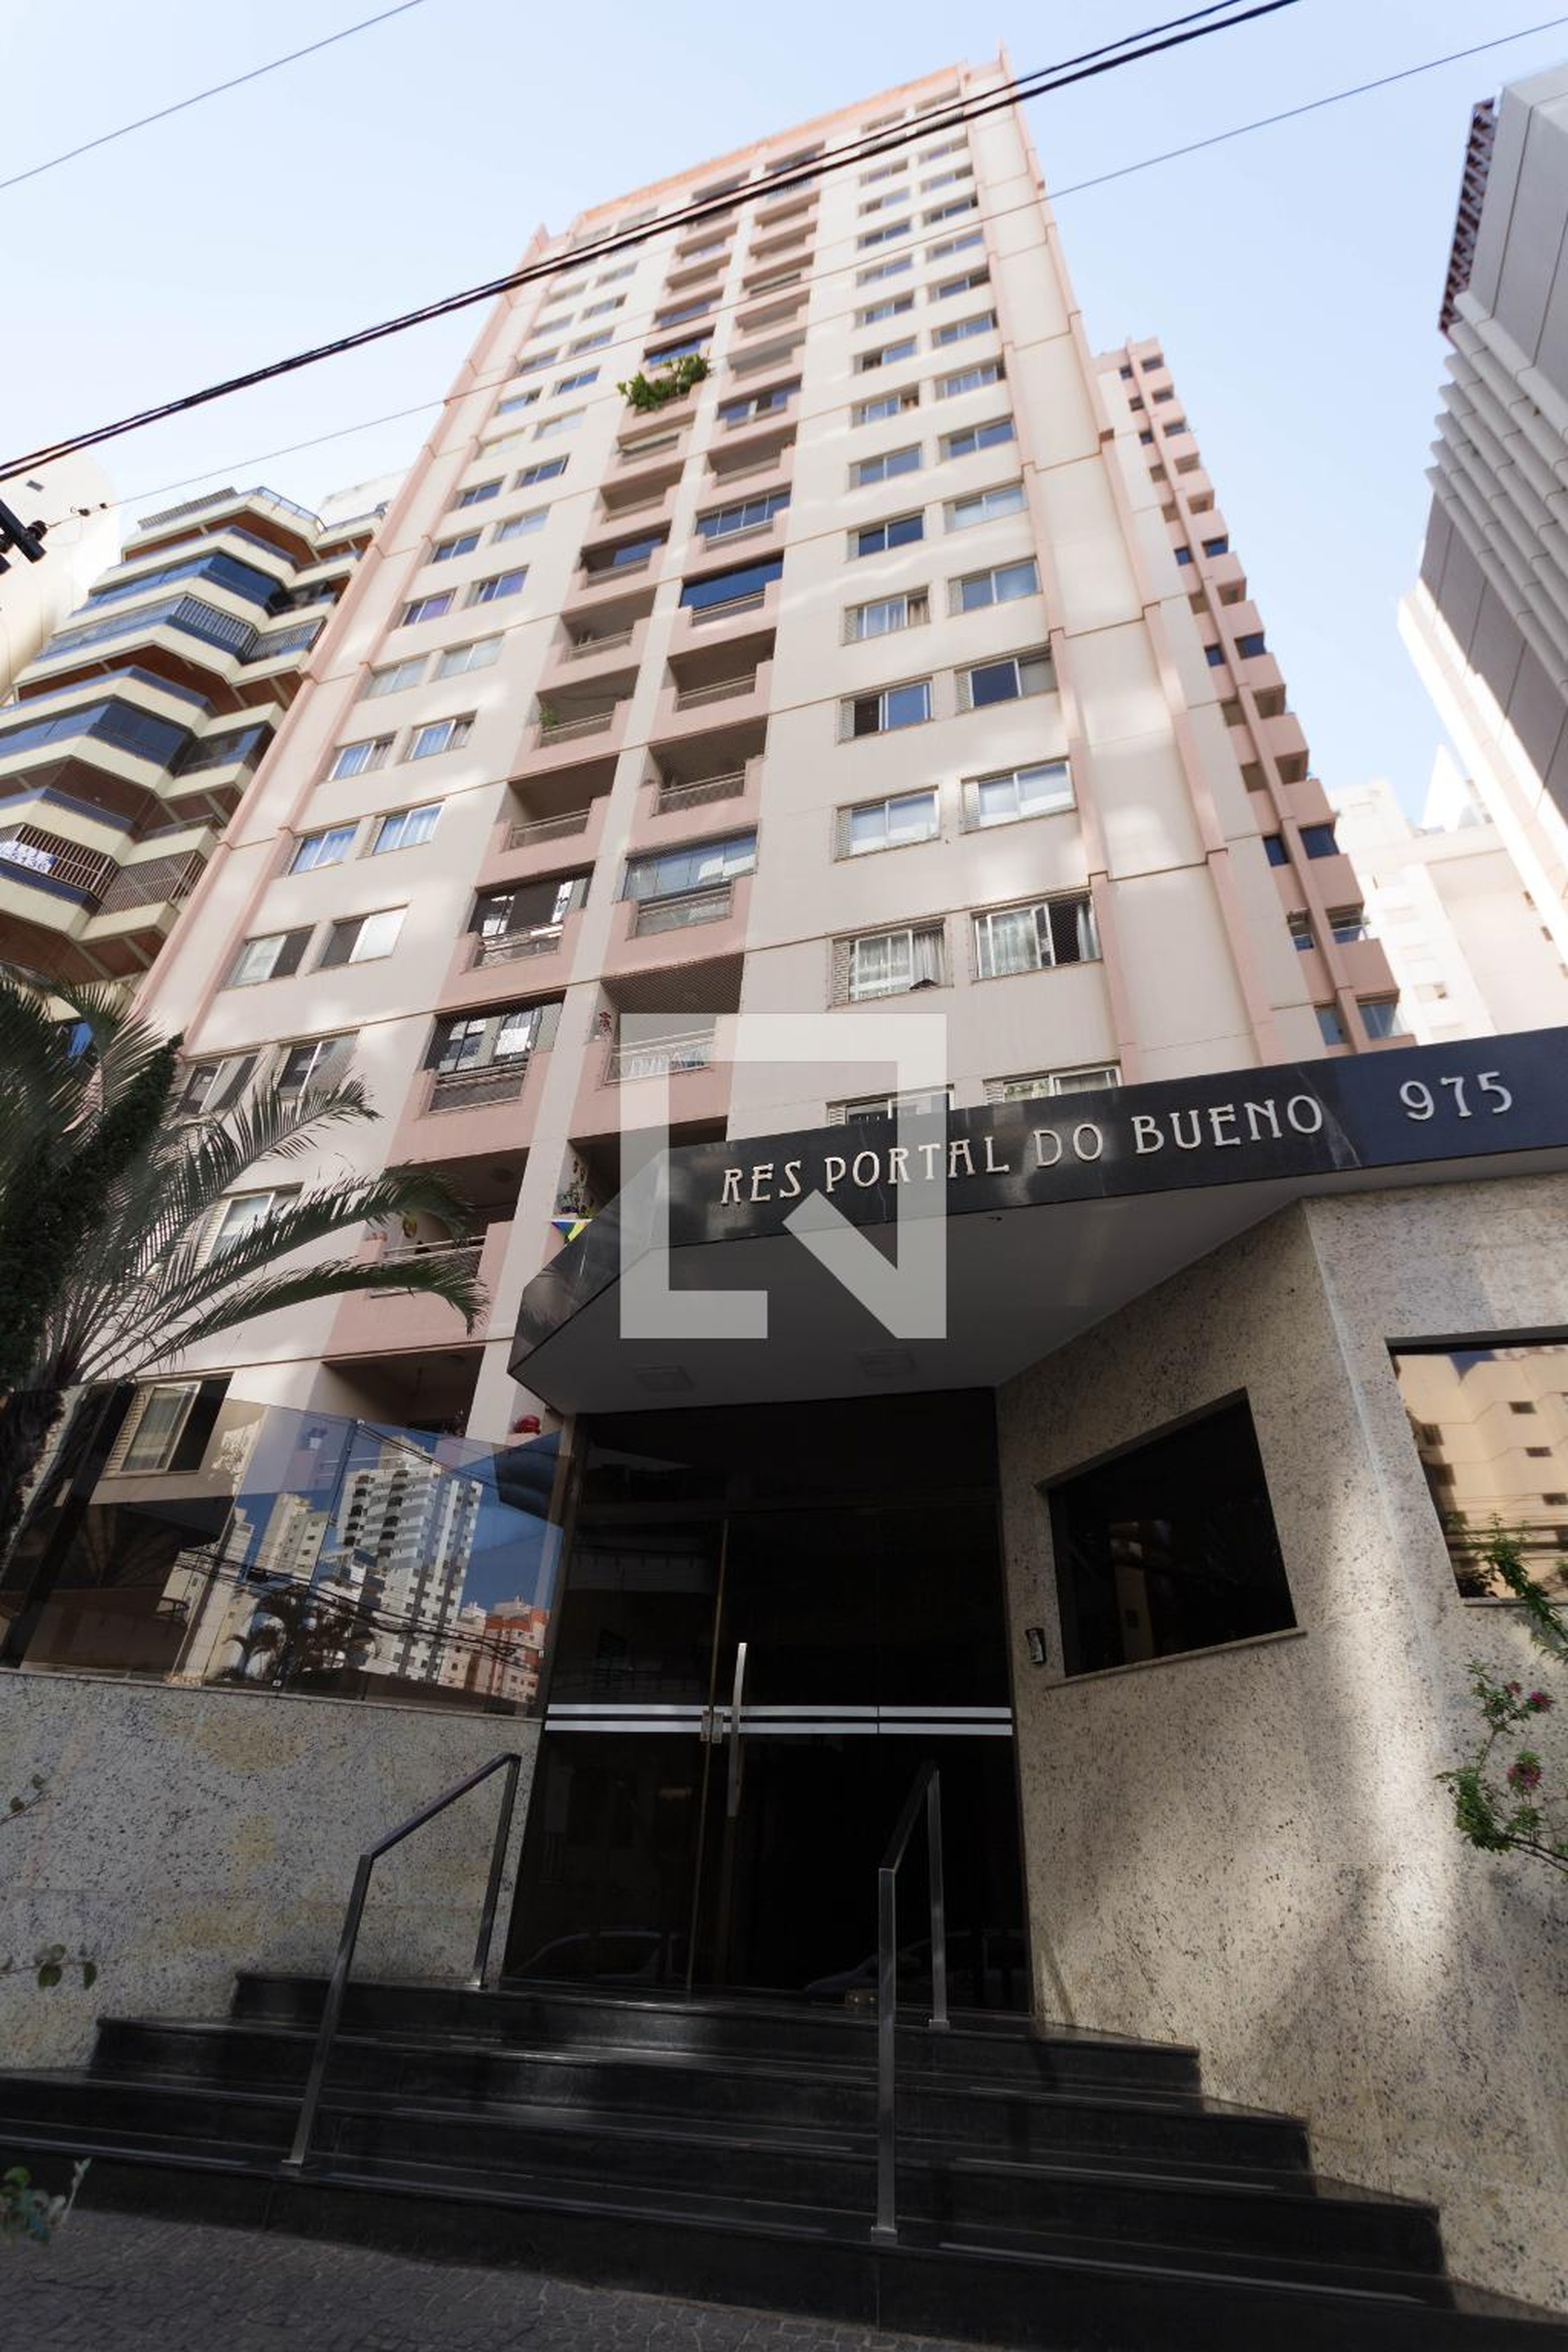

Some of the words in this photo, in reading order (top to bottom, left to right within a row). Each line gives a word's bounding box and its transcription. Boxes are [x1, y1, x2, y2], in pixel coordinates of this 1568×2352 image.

[720, 1160, 802, 1205] RES
[824, 1136, 1010, 1193] PORTAL
[1033, 1123, 1103, 1168] DO
[1131, 1094, 1323, 1154] BUENO
[1399, 1071, 1512, 1120] 975
